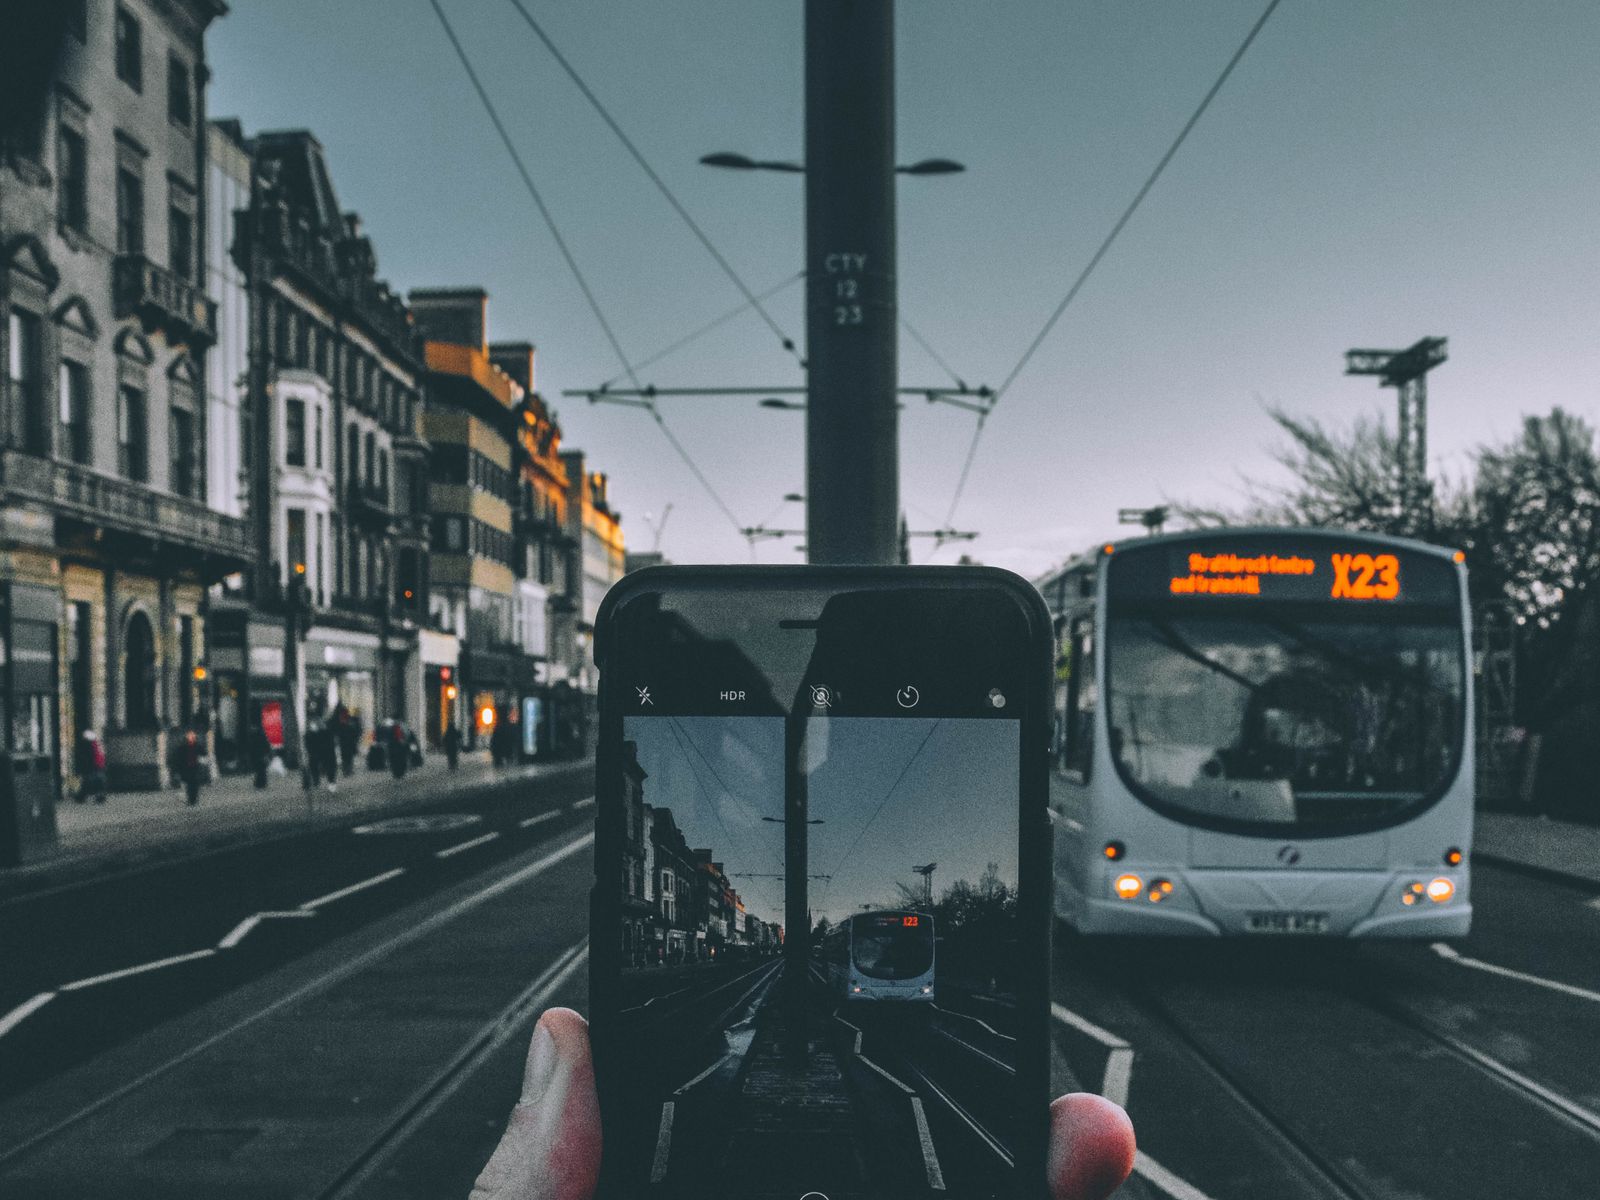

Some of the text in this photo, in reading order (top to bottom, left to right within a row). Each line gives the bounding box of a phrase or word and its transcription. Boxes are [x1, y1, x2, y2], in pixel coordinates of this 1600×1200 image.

[825, 253, 867, 272] CTY
[1331, 553, 1400, 600] X23
[720, 690, 746, 701] HDR
